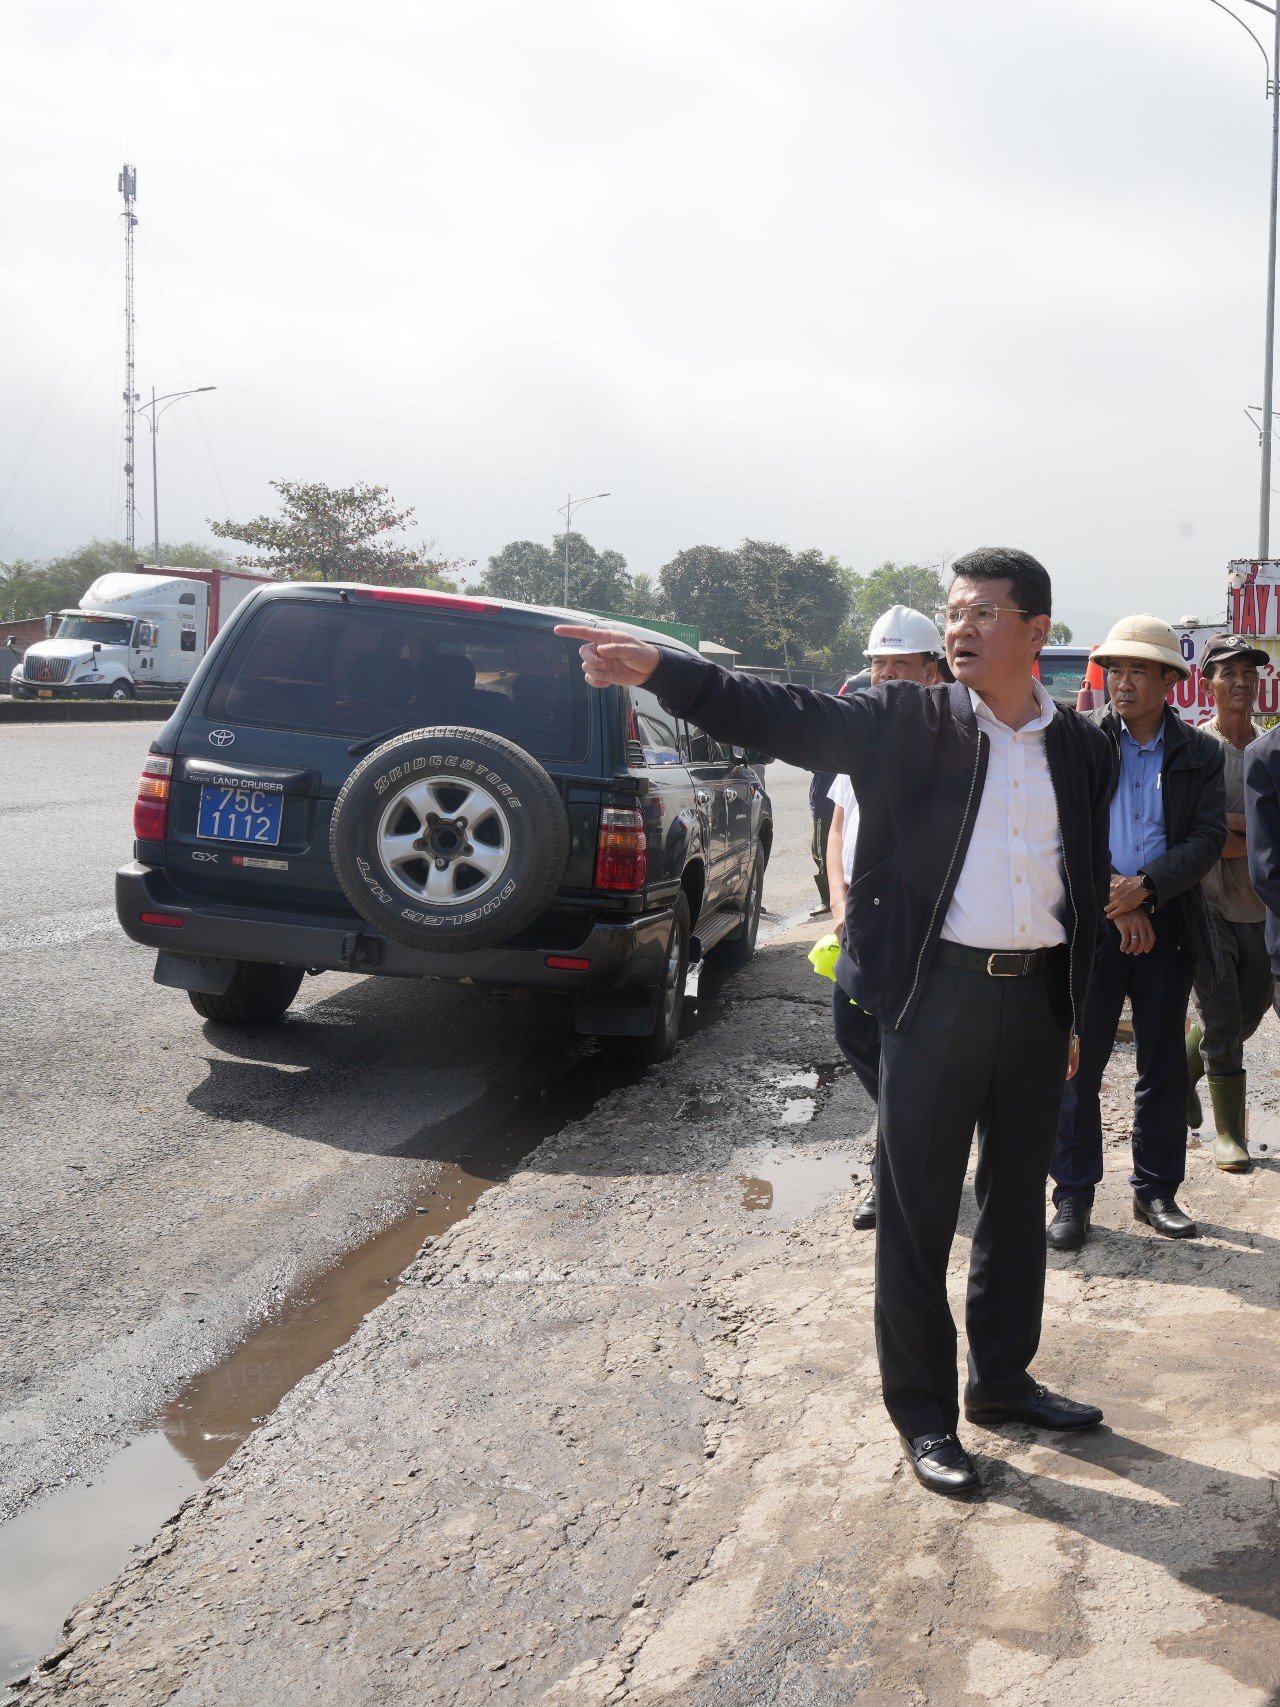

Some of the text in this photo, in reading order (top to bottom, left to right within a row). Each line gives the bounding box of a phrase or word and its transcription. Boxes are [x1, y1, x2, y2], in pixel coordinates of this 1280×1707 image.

[1231, 564, 1271, 634] TẨY
[213, 776, 239, 788] LAND
[240, 779, 284, 792] CRUISER
[374, 755, 522, 809] BRIDGESTONE
[218, 787, 267, 814] 75C
[212, 811, 271, 841] 1112
[191, 851, 219, 864] GX
[401, 879, 516, 926] DUELER
